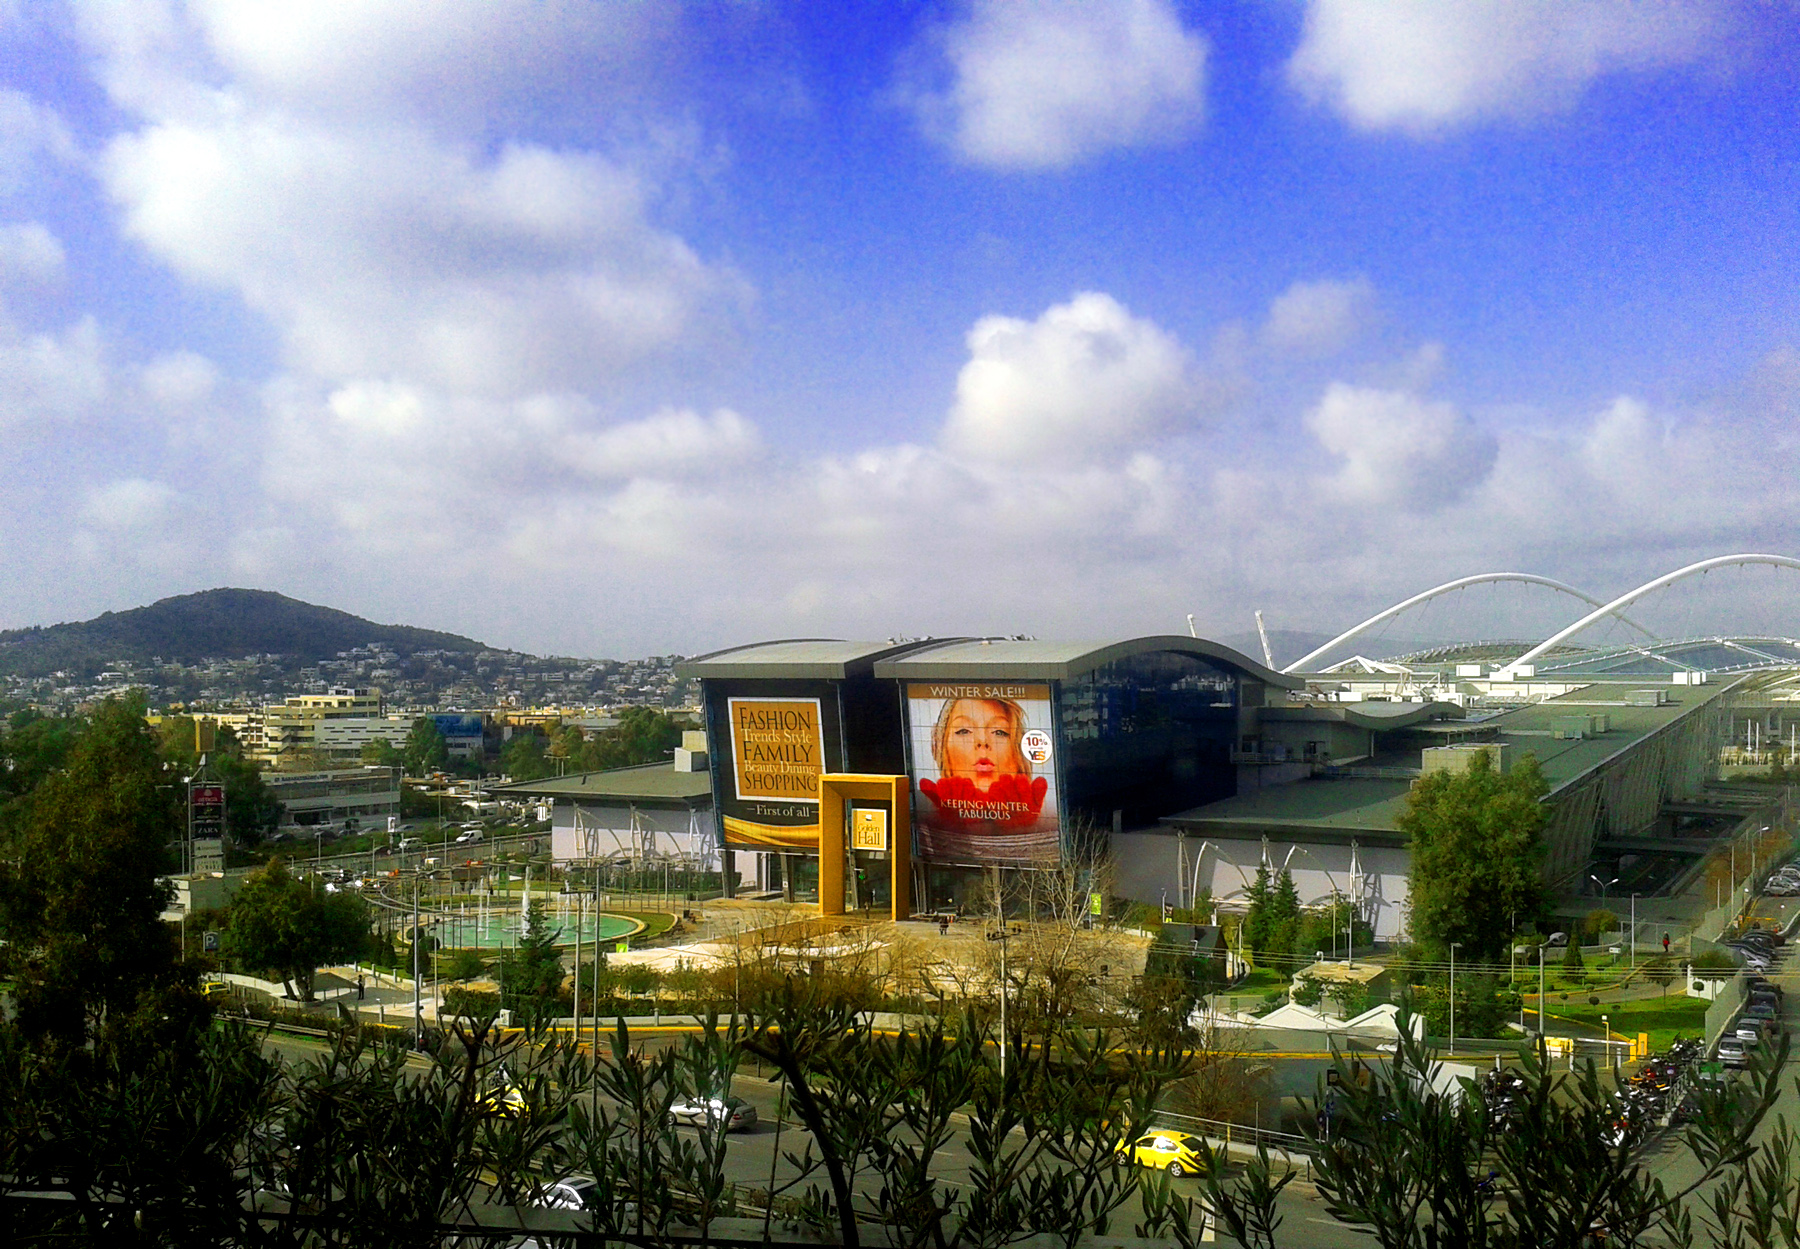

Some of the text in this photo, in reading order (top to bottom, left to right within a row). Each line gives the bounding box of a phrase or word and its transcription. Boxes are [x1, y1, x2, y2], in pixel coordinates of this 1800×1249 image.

[930, 686, 1026, 698] WINTER SALE!!!
[739, 707, 811, 731] FASHION
[741, 729, 812, 748] Trends Style
[1026, 736, 1048, 747] 10%
[743, 741, 813, 763] FAMILY
[744, 760, 817, 777] Beauty Dining
[744, 771, 818, 792] SHOPPING
[756, 804, 810, 818] First of all
[940, 799, 1030, 812] KEEPING WINTER
[959, 808, 1011, 820] FABULOUS
[197, 826, 219, 834] ZARA
[858, 831, 880, 846] Hall
